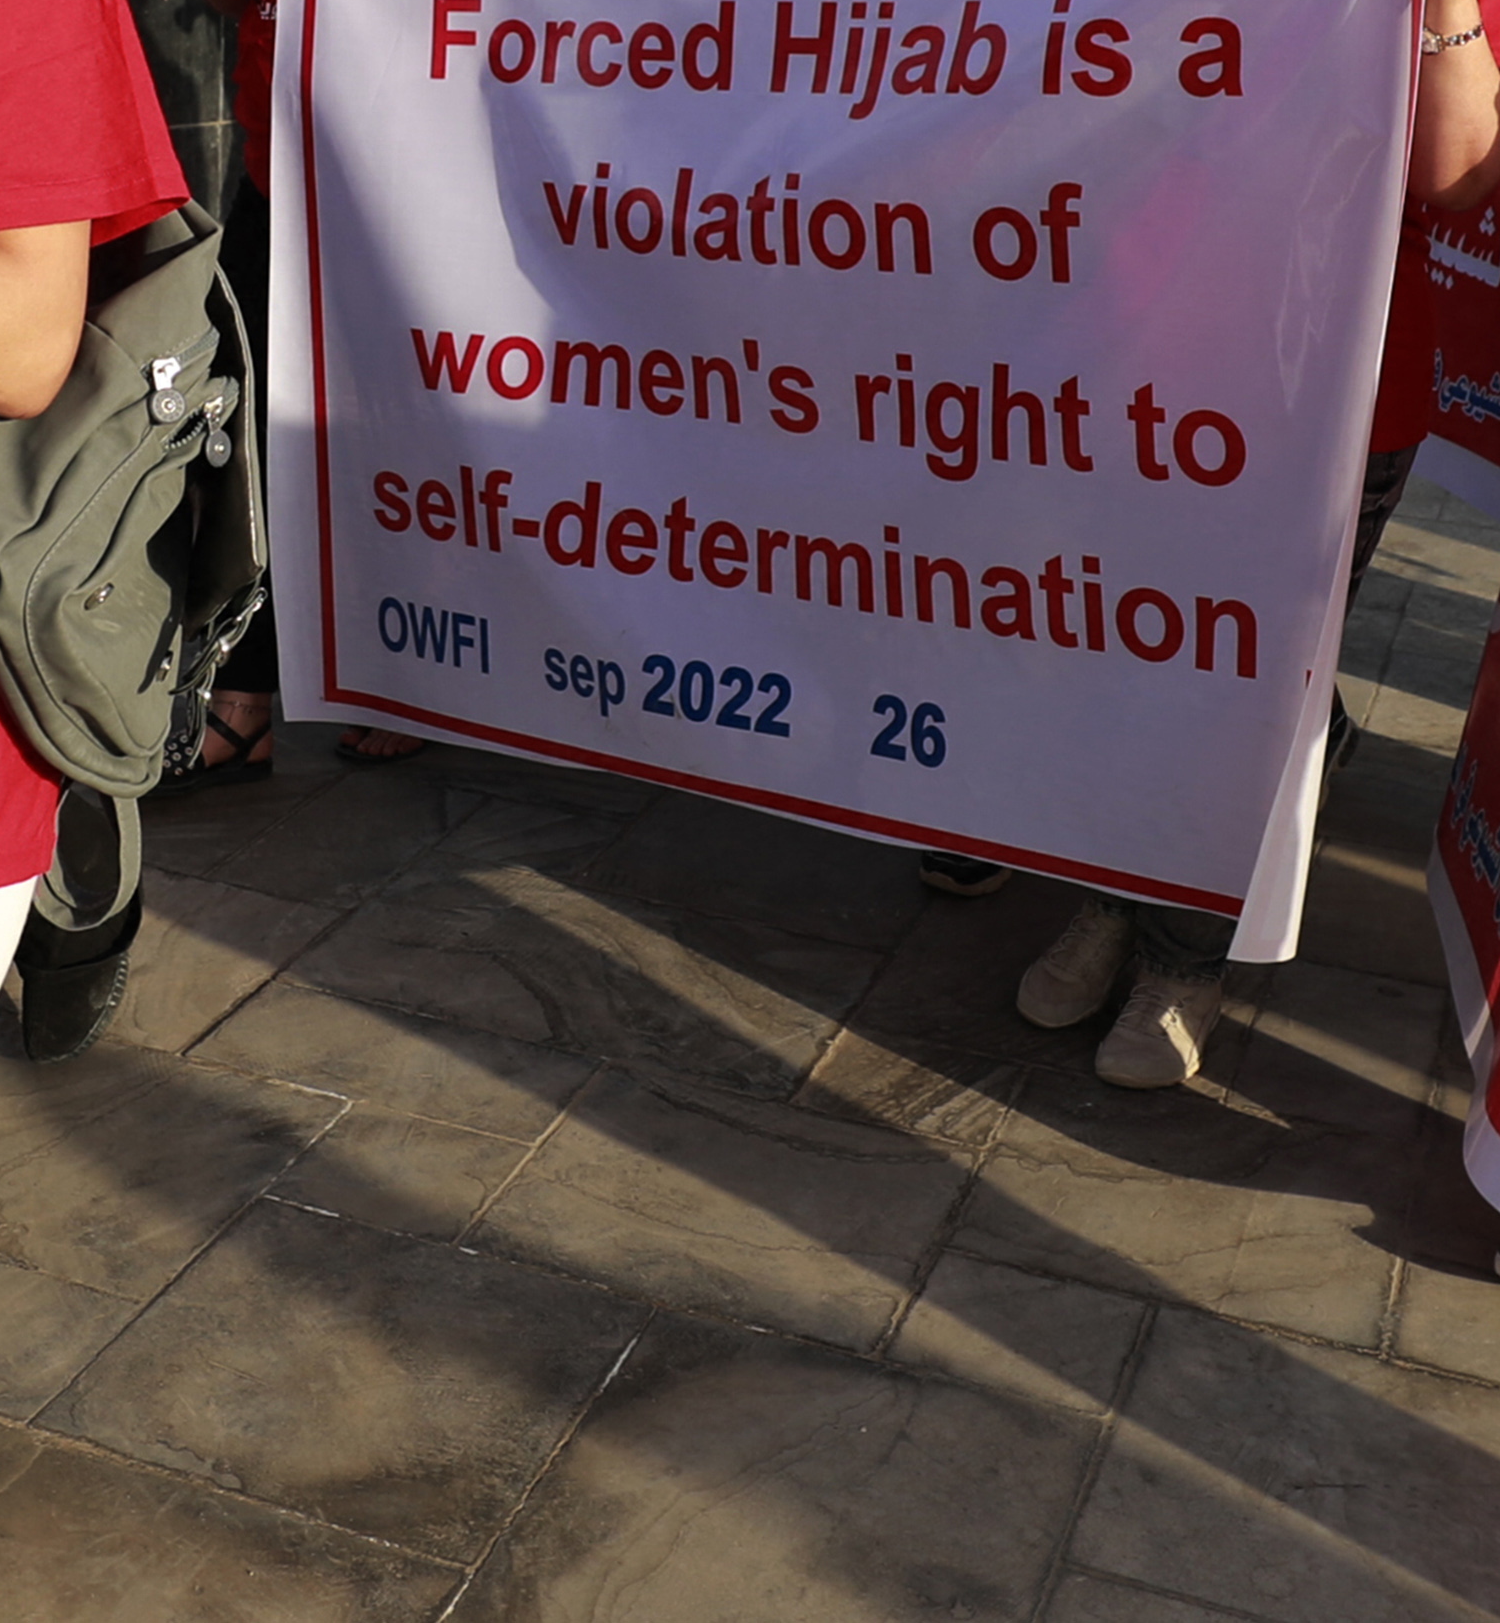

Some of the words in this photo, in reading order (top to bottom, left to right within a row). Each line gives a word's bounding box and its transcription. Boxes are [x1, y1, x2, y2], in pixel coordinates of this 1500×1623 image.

[770, 0, 1008, 120] Hijab
[1178, 15, 1245, 99] a
[544, 161, 933, 275] violation
[973, 182, 1084, 284] of
[411, 327, 820, 435] women's
[856, 353, 1094, 482] right
[1126, 382, 1248, 488] to
[373, 465, 1259, 679] self-determination
[377, 594, 491, 675] OWFI
[543, 640, 627, 719] sep
[640, 652, 793, 739] 2022
[870, 692, 948, 769] 26
